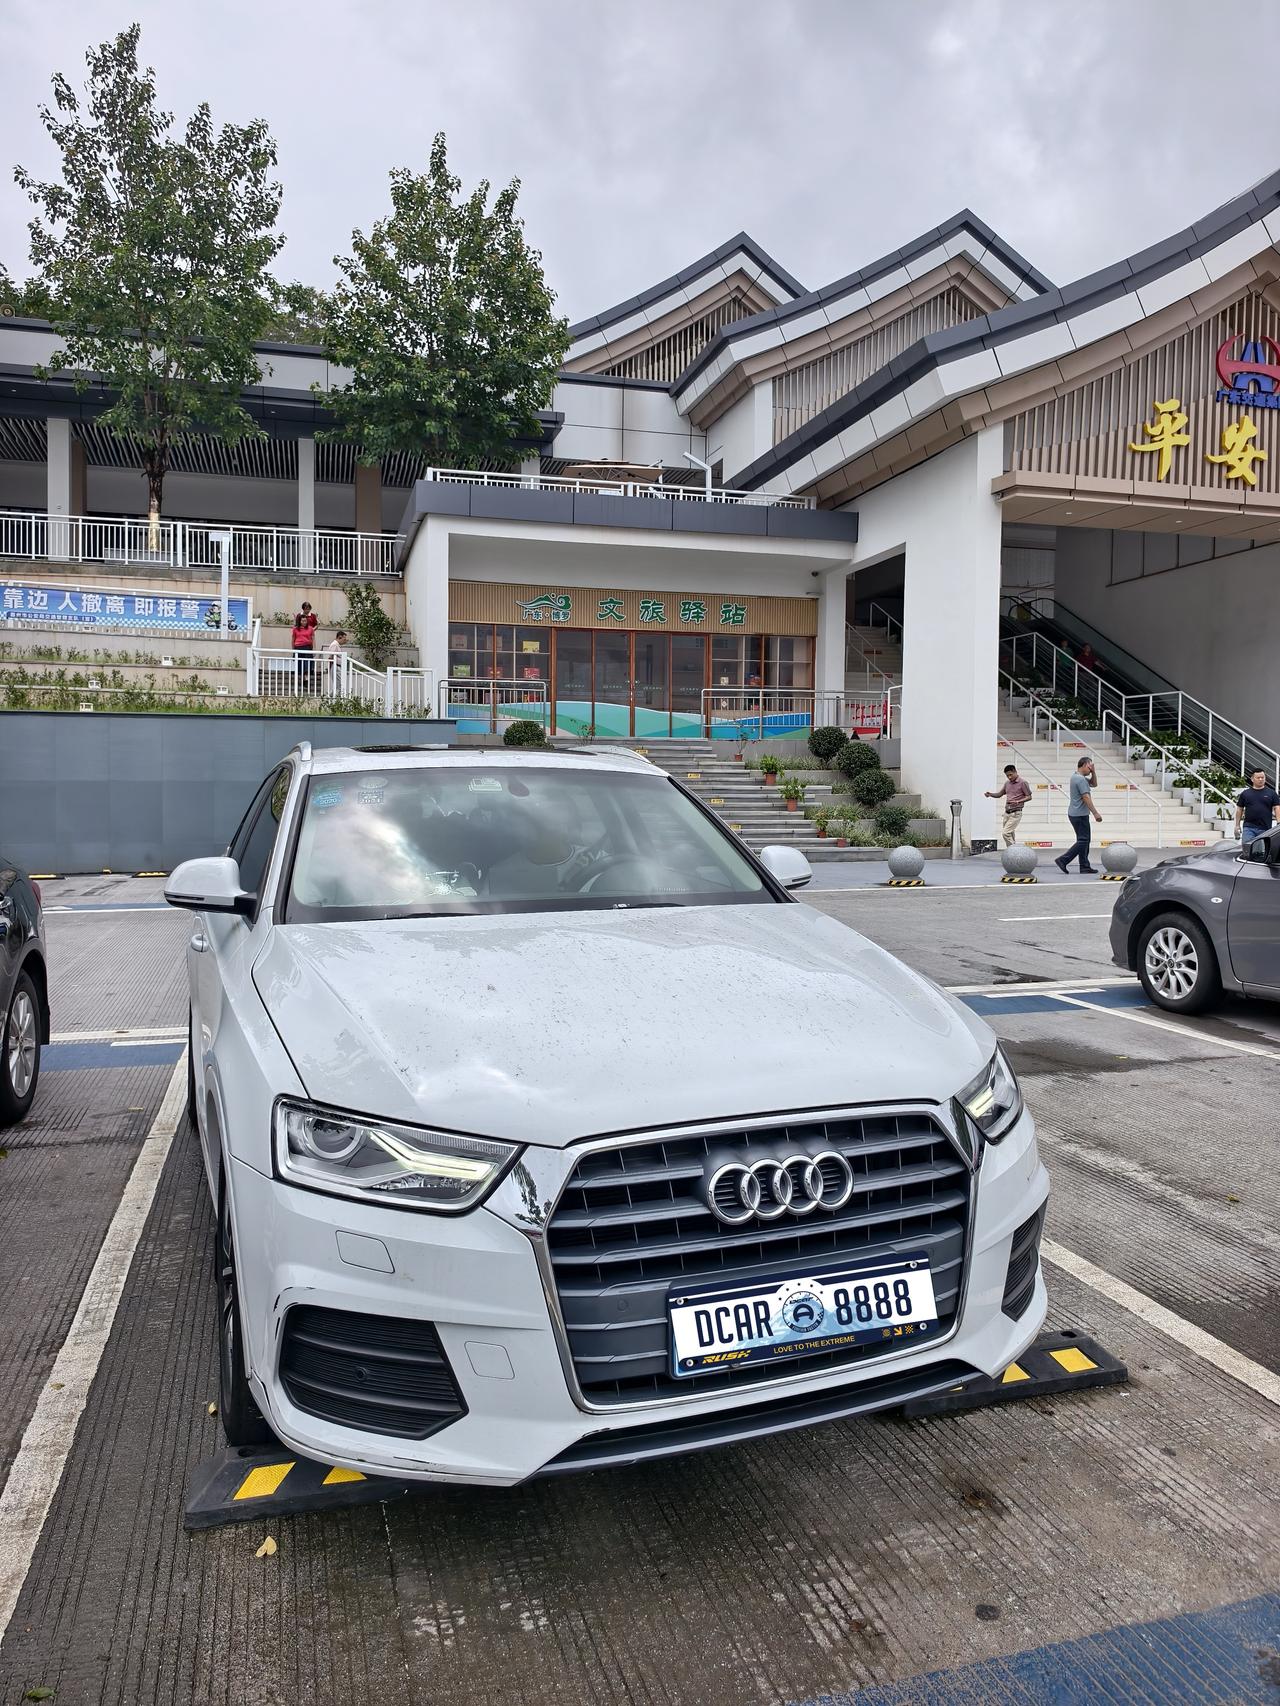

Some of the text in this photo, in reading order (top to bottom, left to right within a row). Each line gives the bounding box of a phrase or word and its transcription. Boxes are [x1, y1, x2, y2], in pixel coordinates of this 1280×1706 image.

[1216, 389, 1280, 409] 广东交通集
[1128, 398, 1268, 485] 平安
[3, 588, 200, 620] 靠边 人撤离 即报警
[597, 597, 747, 625] 文旅驿站
[694, 1279, 913, 1348] DCAR 8888
[773, 1335, 855, 1354] LOVE TO THE EXTREME
